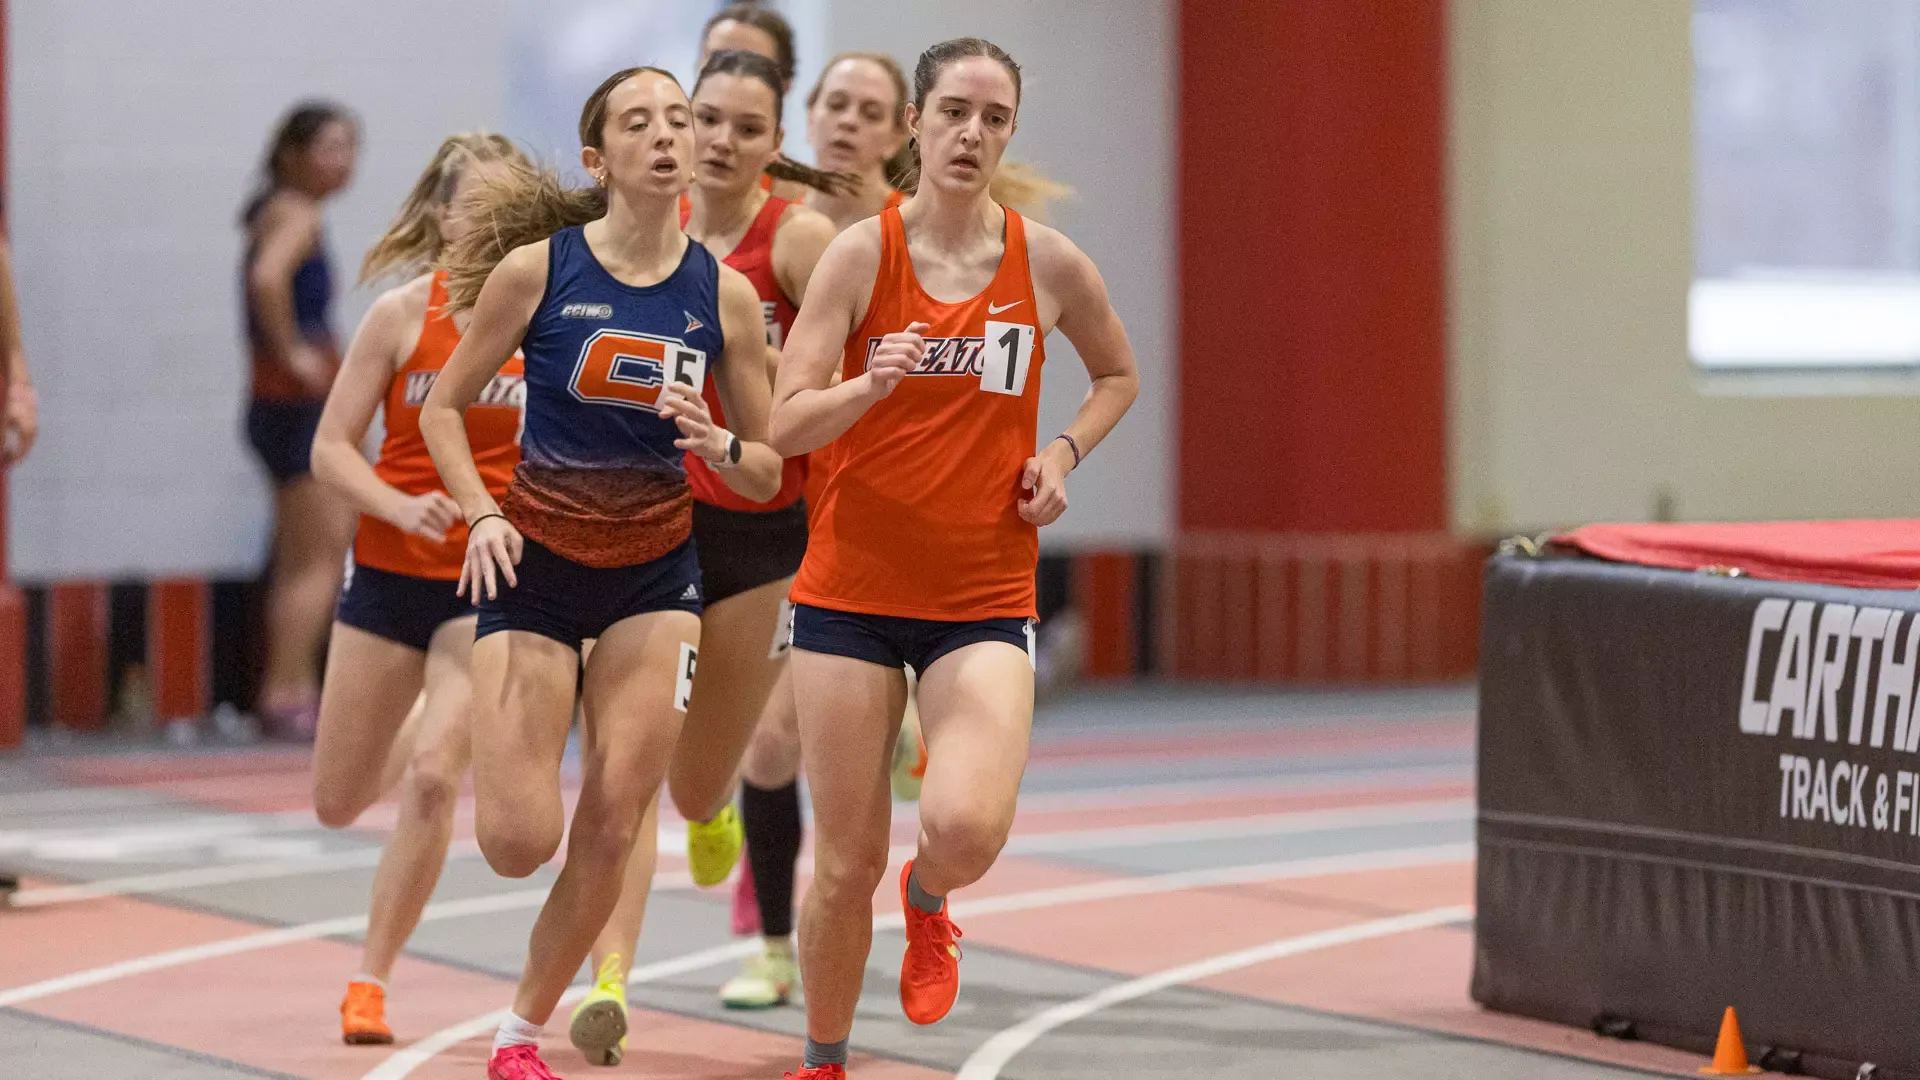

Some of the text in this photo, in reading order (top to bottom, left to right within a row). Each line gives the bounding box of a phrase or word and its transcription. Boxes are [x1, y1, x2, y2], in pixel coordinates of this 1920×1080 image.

[675, 350, 697, 396] 5
[998, 327, 1020, 391] 1
[1779, 754, 1920, 836] TRACK & FI
